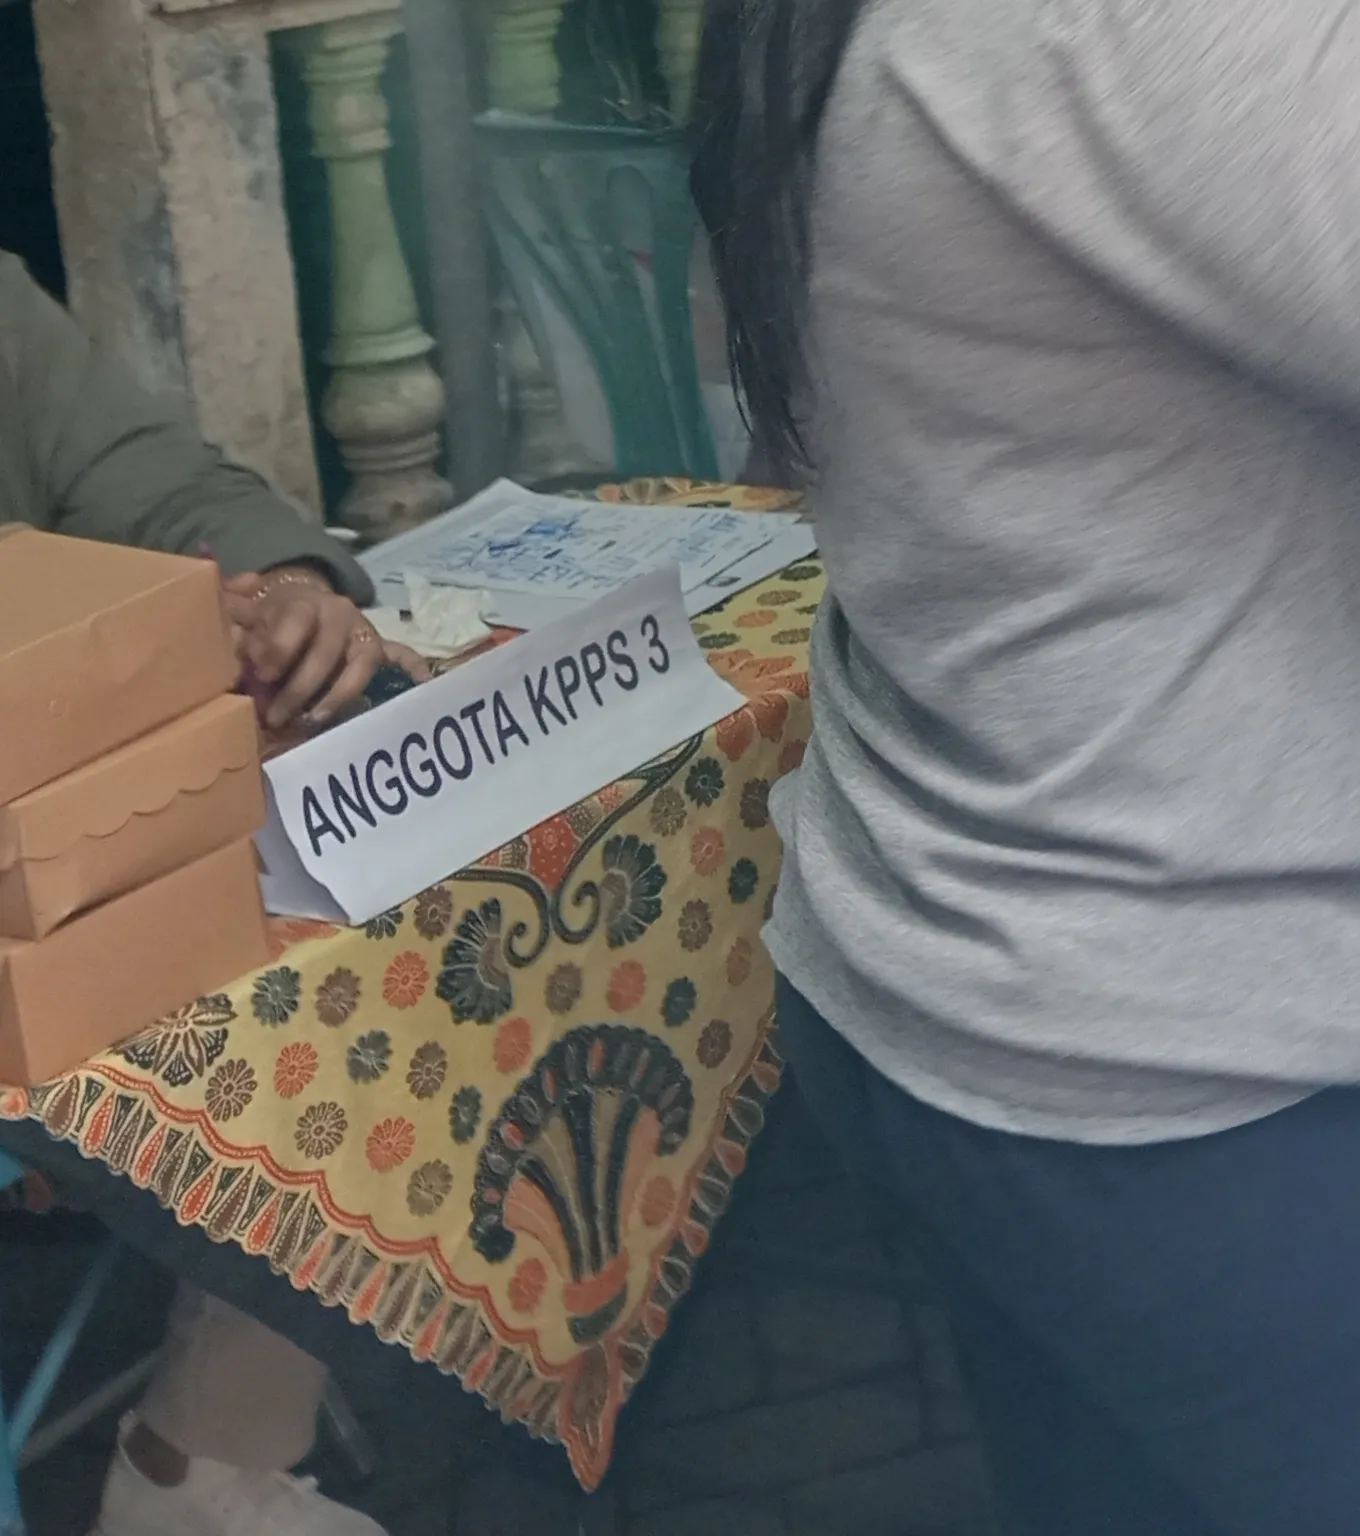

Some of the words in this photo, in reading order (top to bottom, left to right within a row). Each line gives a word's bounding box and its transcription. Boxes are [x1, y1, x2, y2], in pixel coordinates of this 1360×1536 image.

[300, 689, 529, 857] ANGGOTA
[524, 630, 640, 735] KPPS
[640, 614, 671, 674] 3
